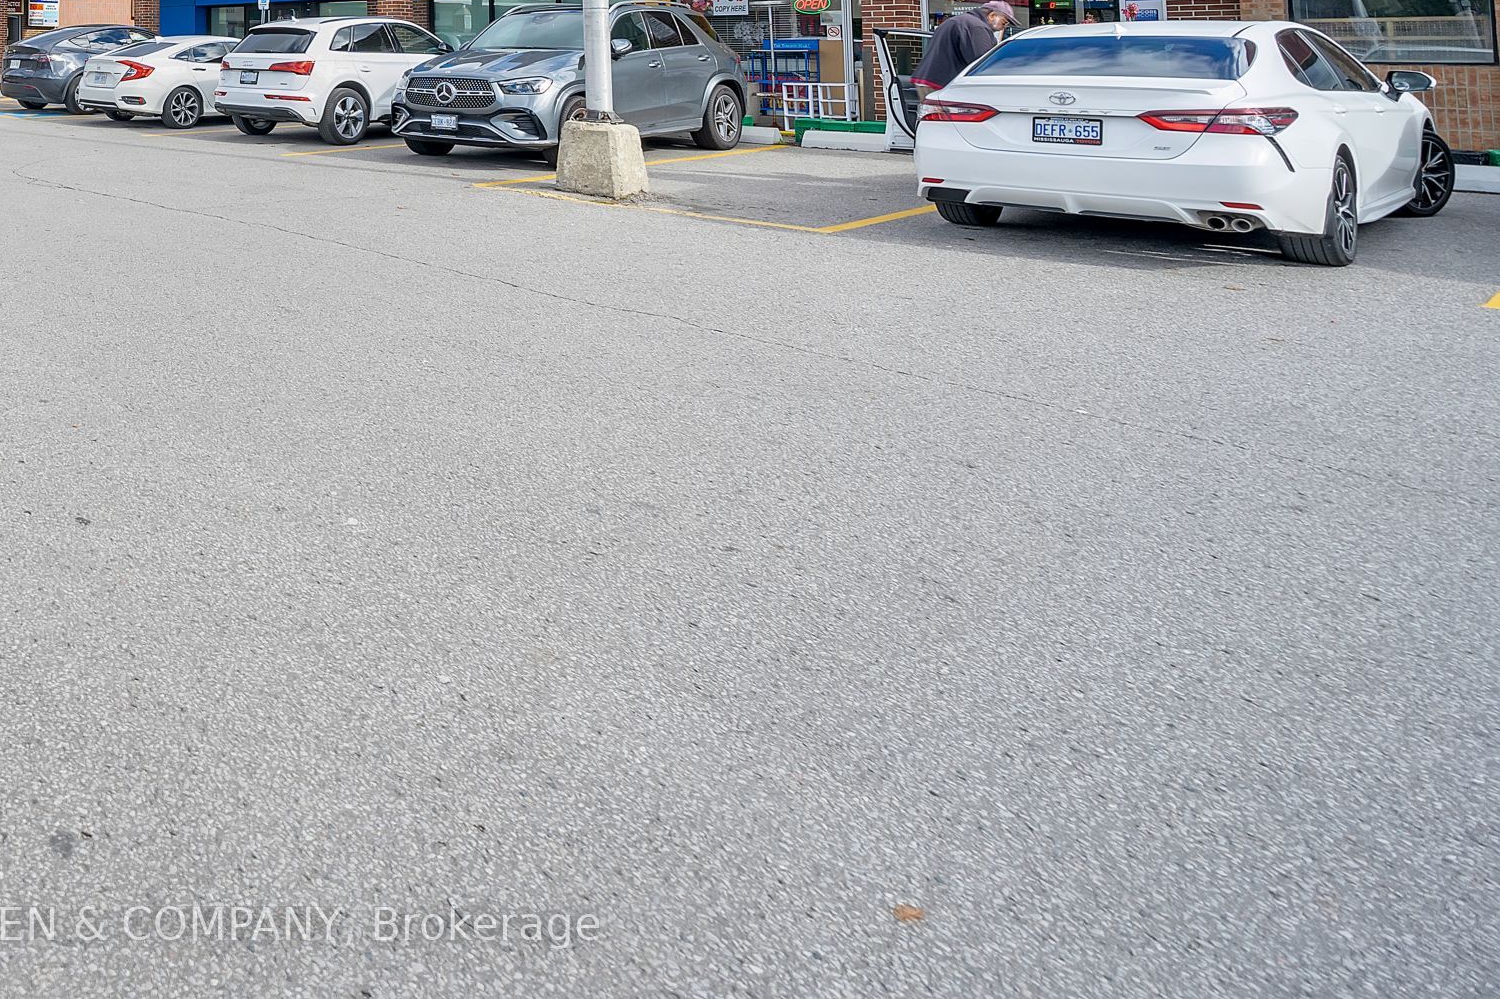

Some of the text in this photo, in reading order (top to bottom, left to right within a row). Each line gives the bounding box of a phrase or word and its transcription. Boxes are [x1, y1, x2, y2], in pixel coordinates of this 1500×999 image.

[1035, 122, 1099, 138] DEFR 655
[1033, 136, 1075, 144] MISSISSAUGA
